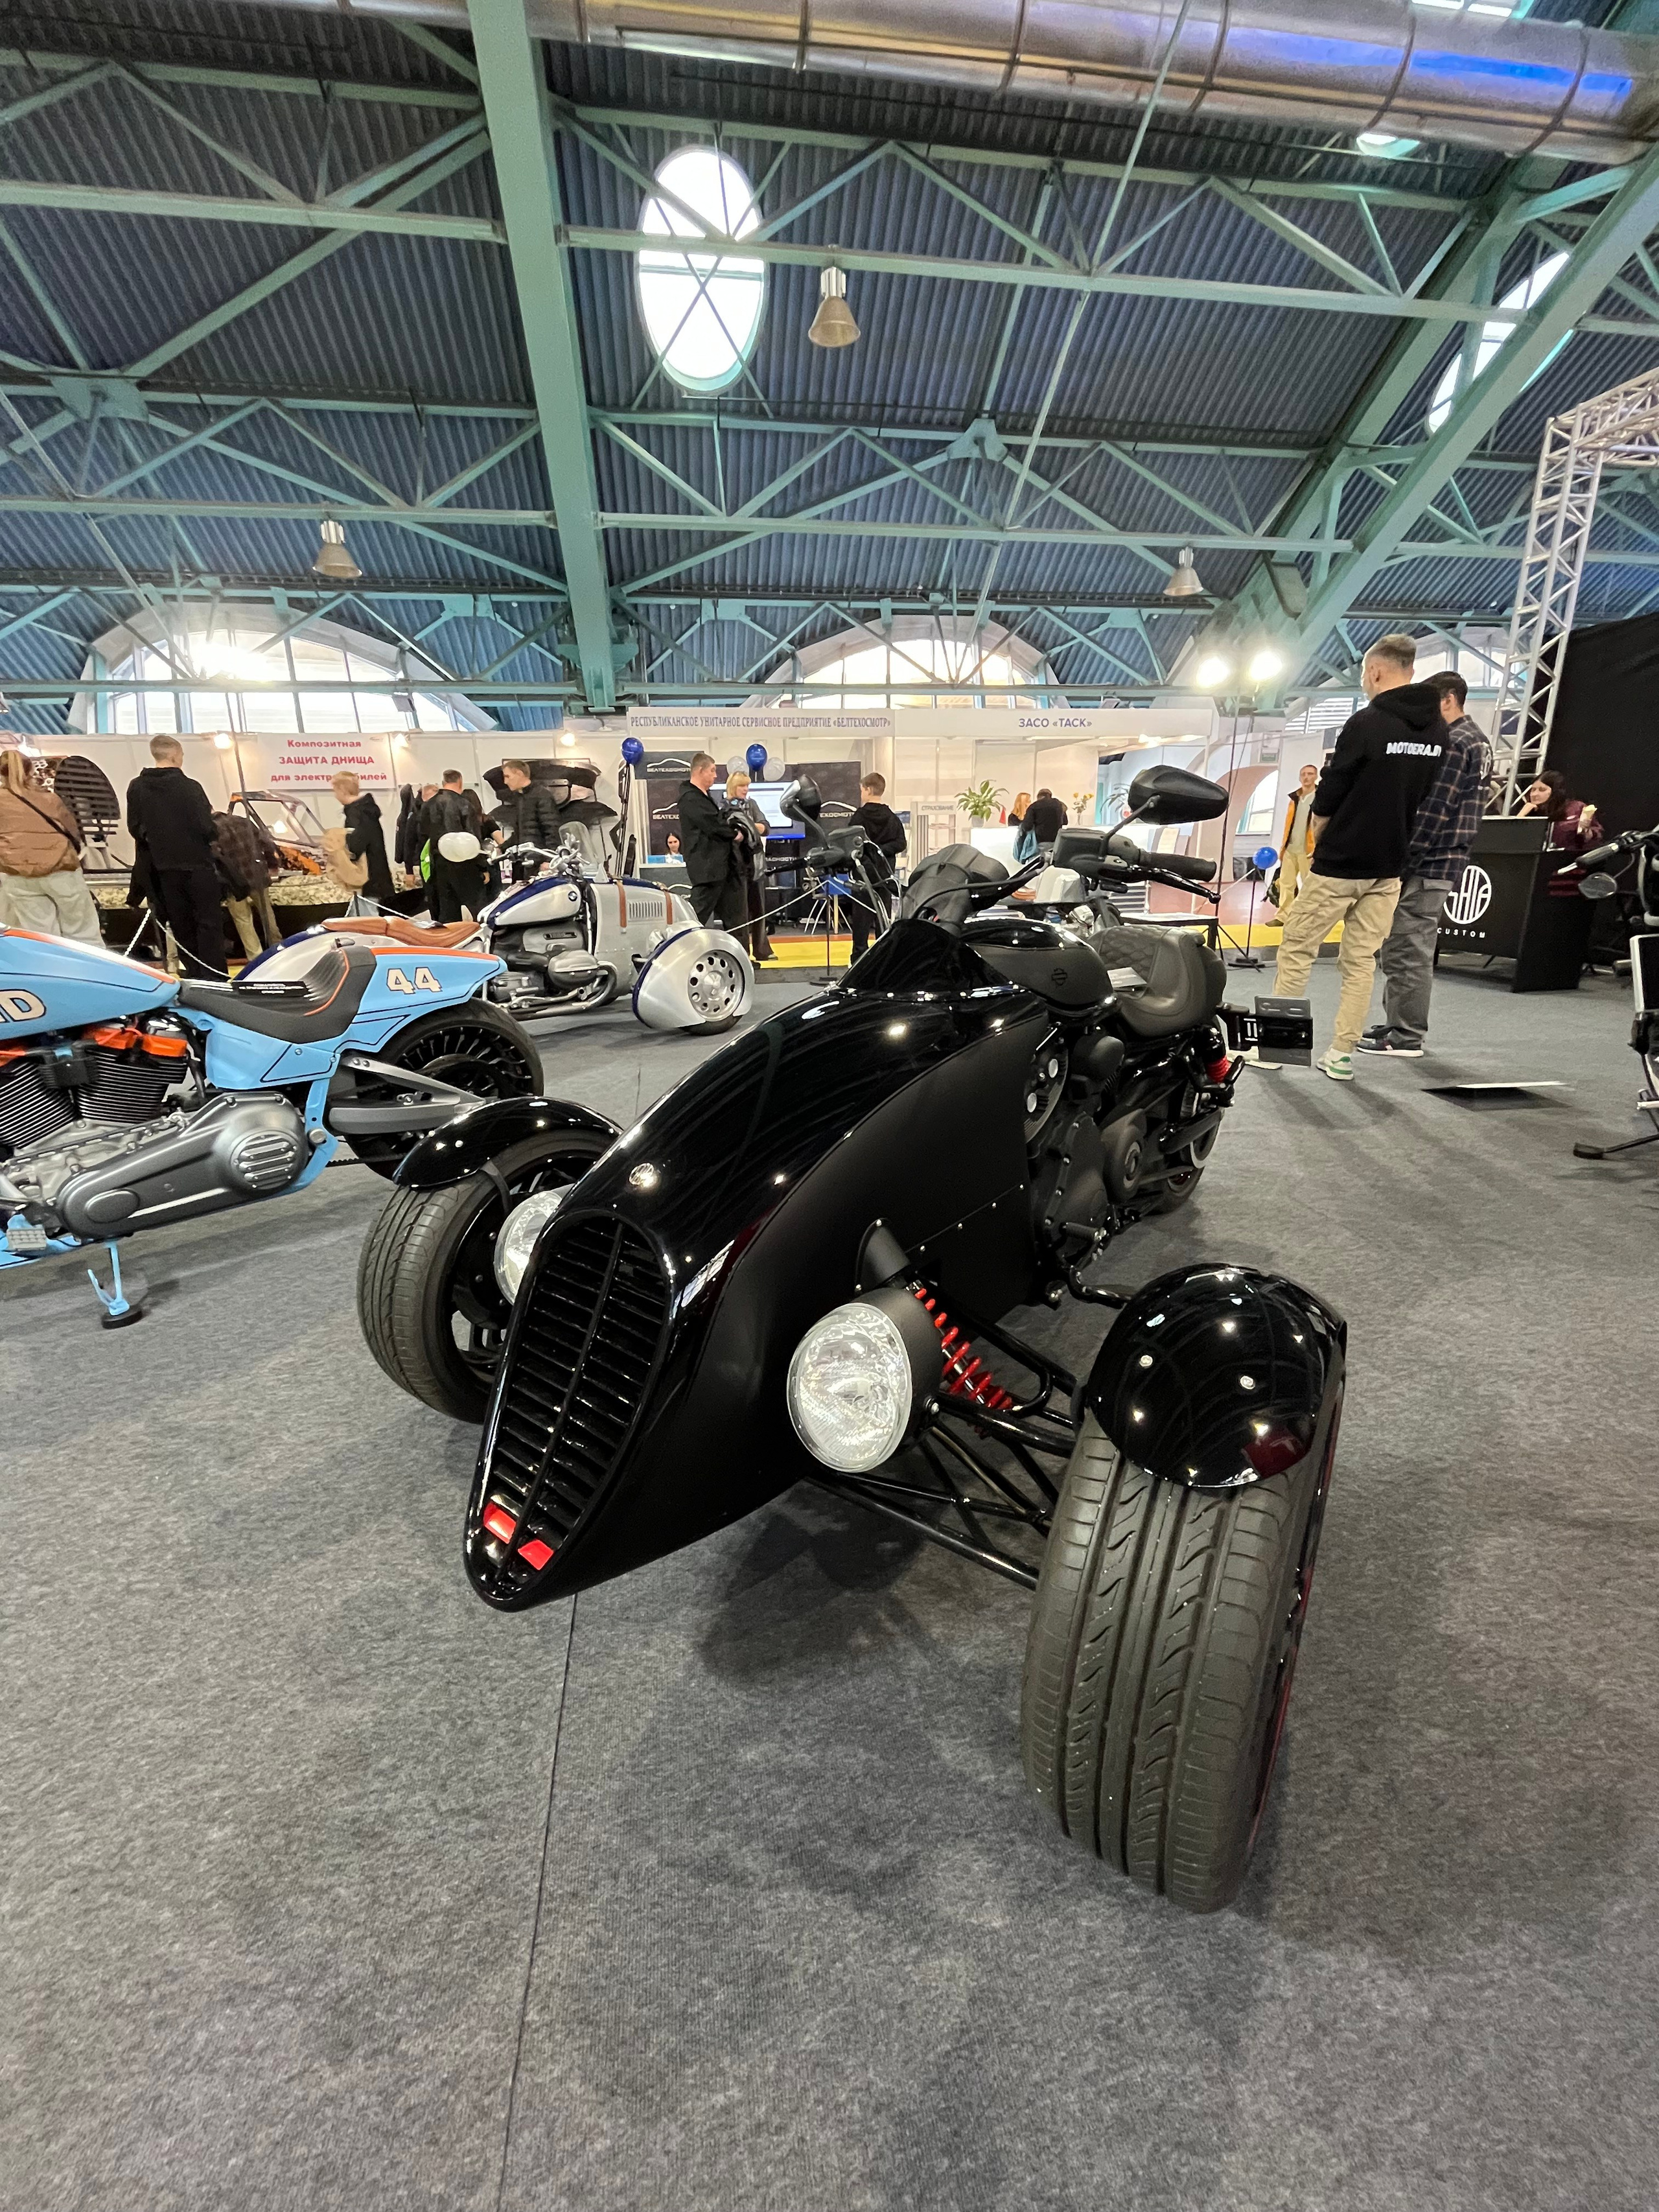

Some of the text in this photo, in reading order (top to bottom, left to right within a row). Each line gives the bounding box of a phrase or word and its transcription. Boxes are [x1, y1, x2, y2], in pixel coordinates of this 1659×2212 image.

[631, 716, 699, 727] РЕСПУБЛИКАНСКОЕ
[701, 716, 741, 727] УНИТАРНОЕ
[742, 717, 782, 727] СЕРВИСНОЕ
[783, 717, 831, 728] ПРЕДПРИЯТИЕ
[1018, 718, 1093, 727] ЗАСО «ТАСК»
[287, 739, 362, 748] Композитная
[279, 756, 375, 765] ЗАЩИТА ДНИЩА
[294, 773, 387, 782] электрилей
[1437, 927, 1485, 938] CUSTOM
[386, 966, 443, 995] 44
